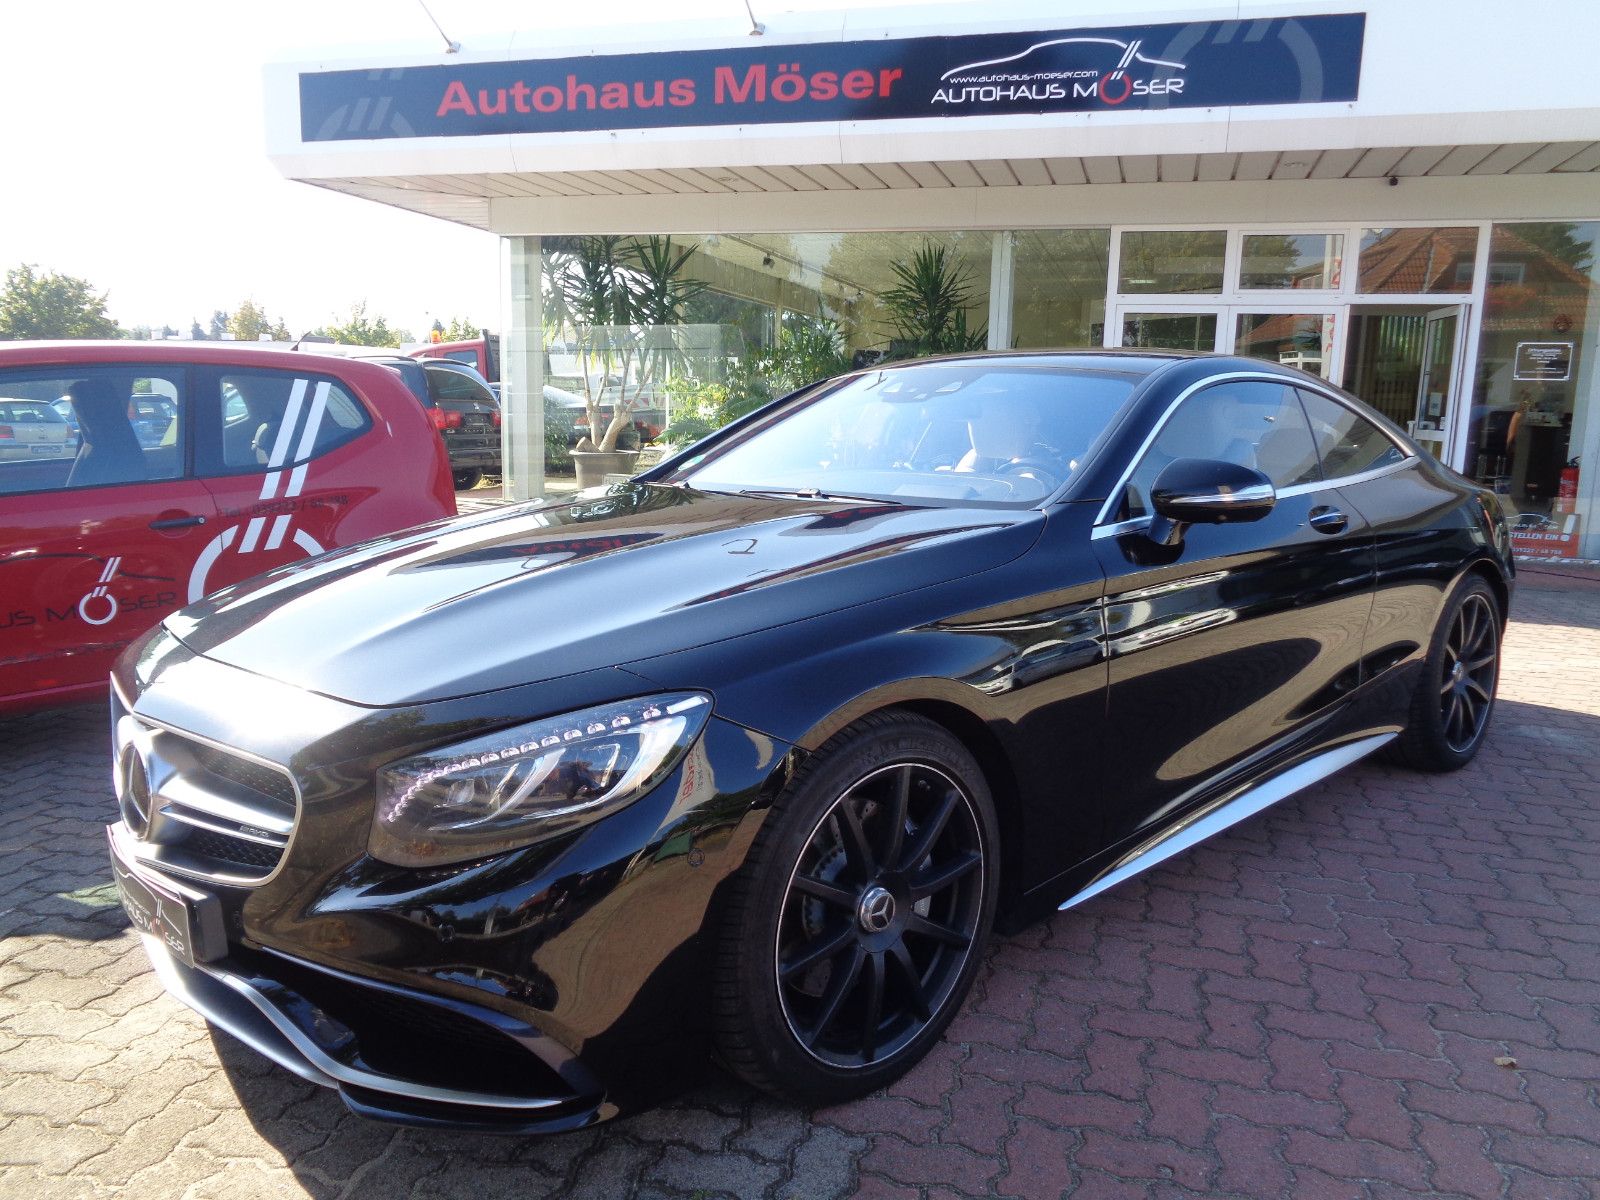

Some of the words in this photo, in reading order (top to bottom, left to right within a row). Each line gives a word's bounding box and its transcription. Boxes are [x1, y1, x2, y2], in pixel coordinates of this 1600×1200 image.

[435, 74, 696, 118] Autohaus
[713, 64, 903, 105] Möser
[931, 83, 1066, 104] AUTOHAUS
[1073, 70, 1186, 105] MÖSER
[949, 70, 1099, 84] www.autohaus-moeser.com
[46, 586, 177, 626] MÖSER
